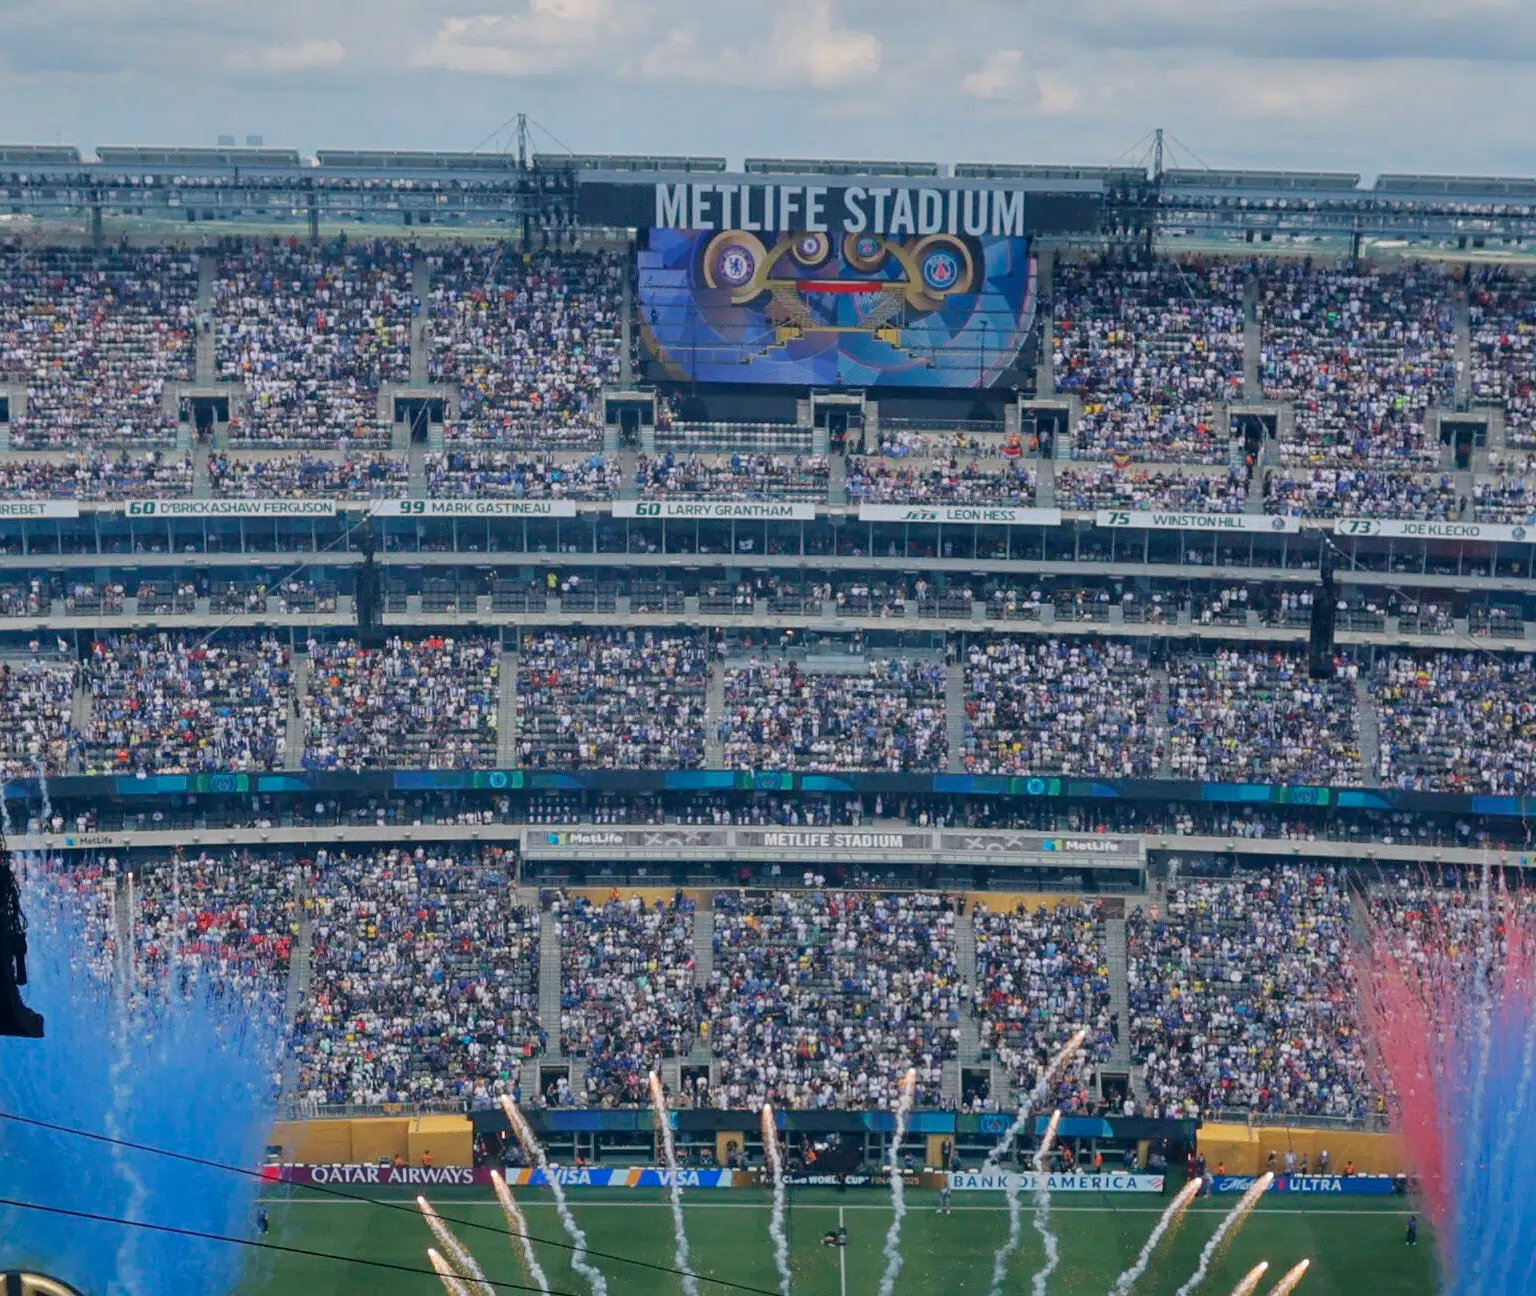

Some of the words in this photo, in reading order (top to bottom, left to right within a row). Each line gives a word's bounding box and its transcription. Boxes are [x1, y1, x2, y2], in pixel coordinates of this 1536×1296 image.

[655, 184, 828, 231] METLIFE
[843, 186, 1025, 236] STADIUM
[129, 502, 155, 514] 60
[263, 502, 333, 513] FERGUSON
[400, 501, 425, 514] 99
[432, 502, 472, 513] MARK
[476, 502, 551, 513] GASTINEAU
[635, 503, 661, 516] 60
[668, 504, 711, 515] LARRY
[714, 505, 793, 516] GRANTHAM
[947, 510, 980, 520] LEON
[983, 510, 1016, 521] HESS
[1108, 512, 1130, 524] 75
[1153, 514, 1216, 527] WINSTON
[1219, 516, 1245, 528] HILL
[1348, 521, 1371, 533] 73
[1400, 523, 1425, 535] JOE
[1428, 524, 1480, 537] KLECKO
[80, 836, 113, 844] MetLife
[570, 833, 623, 844] MetLife
[765, 833, 830, 846] METLIFE
[834, 834, 903, 848] STADIUM
[1066, 840, 1119, 851] MetLife
[312, 1167, 379, 1183] QATAR
[388, 1168, 473, 1184] AIRWAYS
[954, 1175, 1008, 1189] BANK
[1046, 1176, 1138, 1189] AMERICA
[1290, 1179, 1342, 1191] ULTRA
